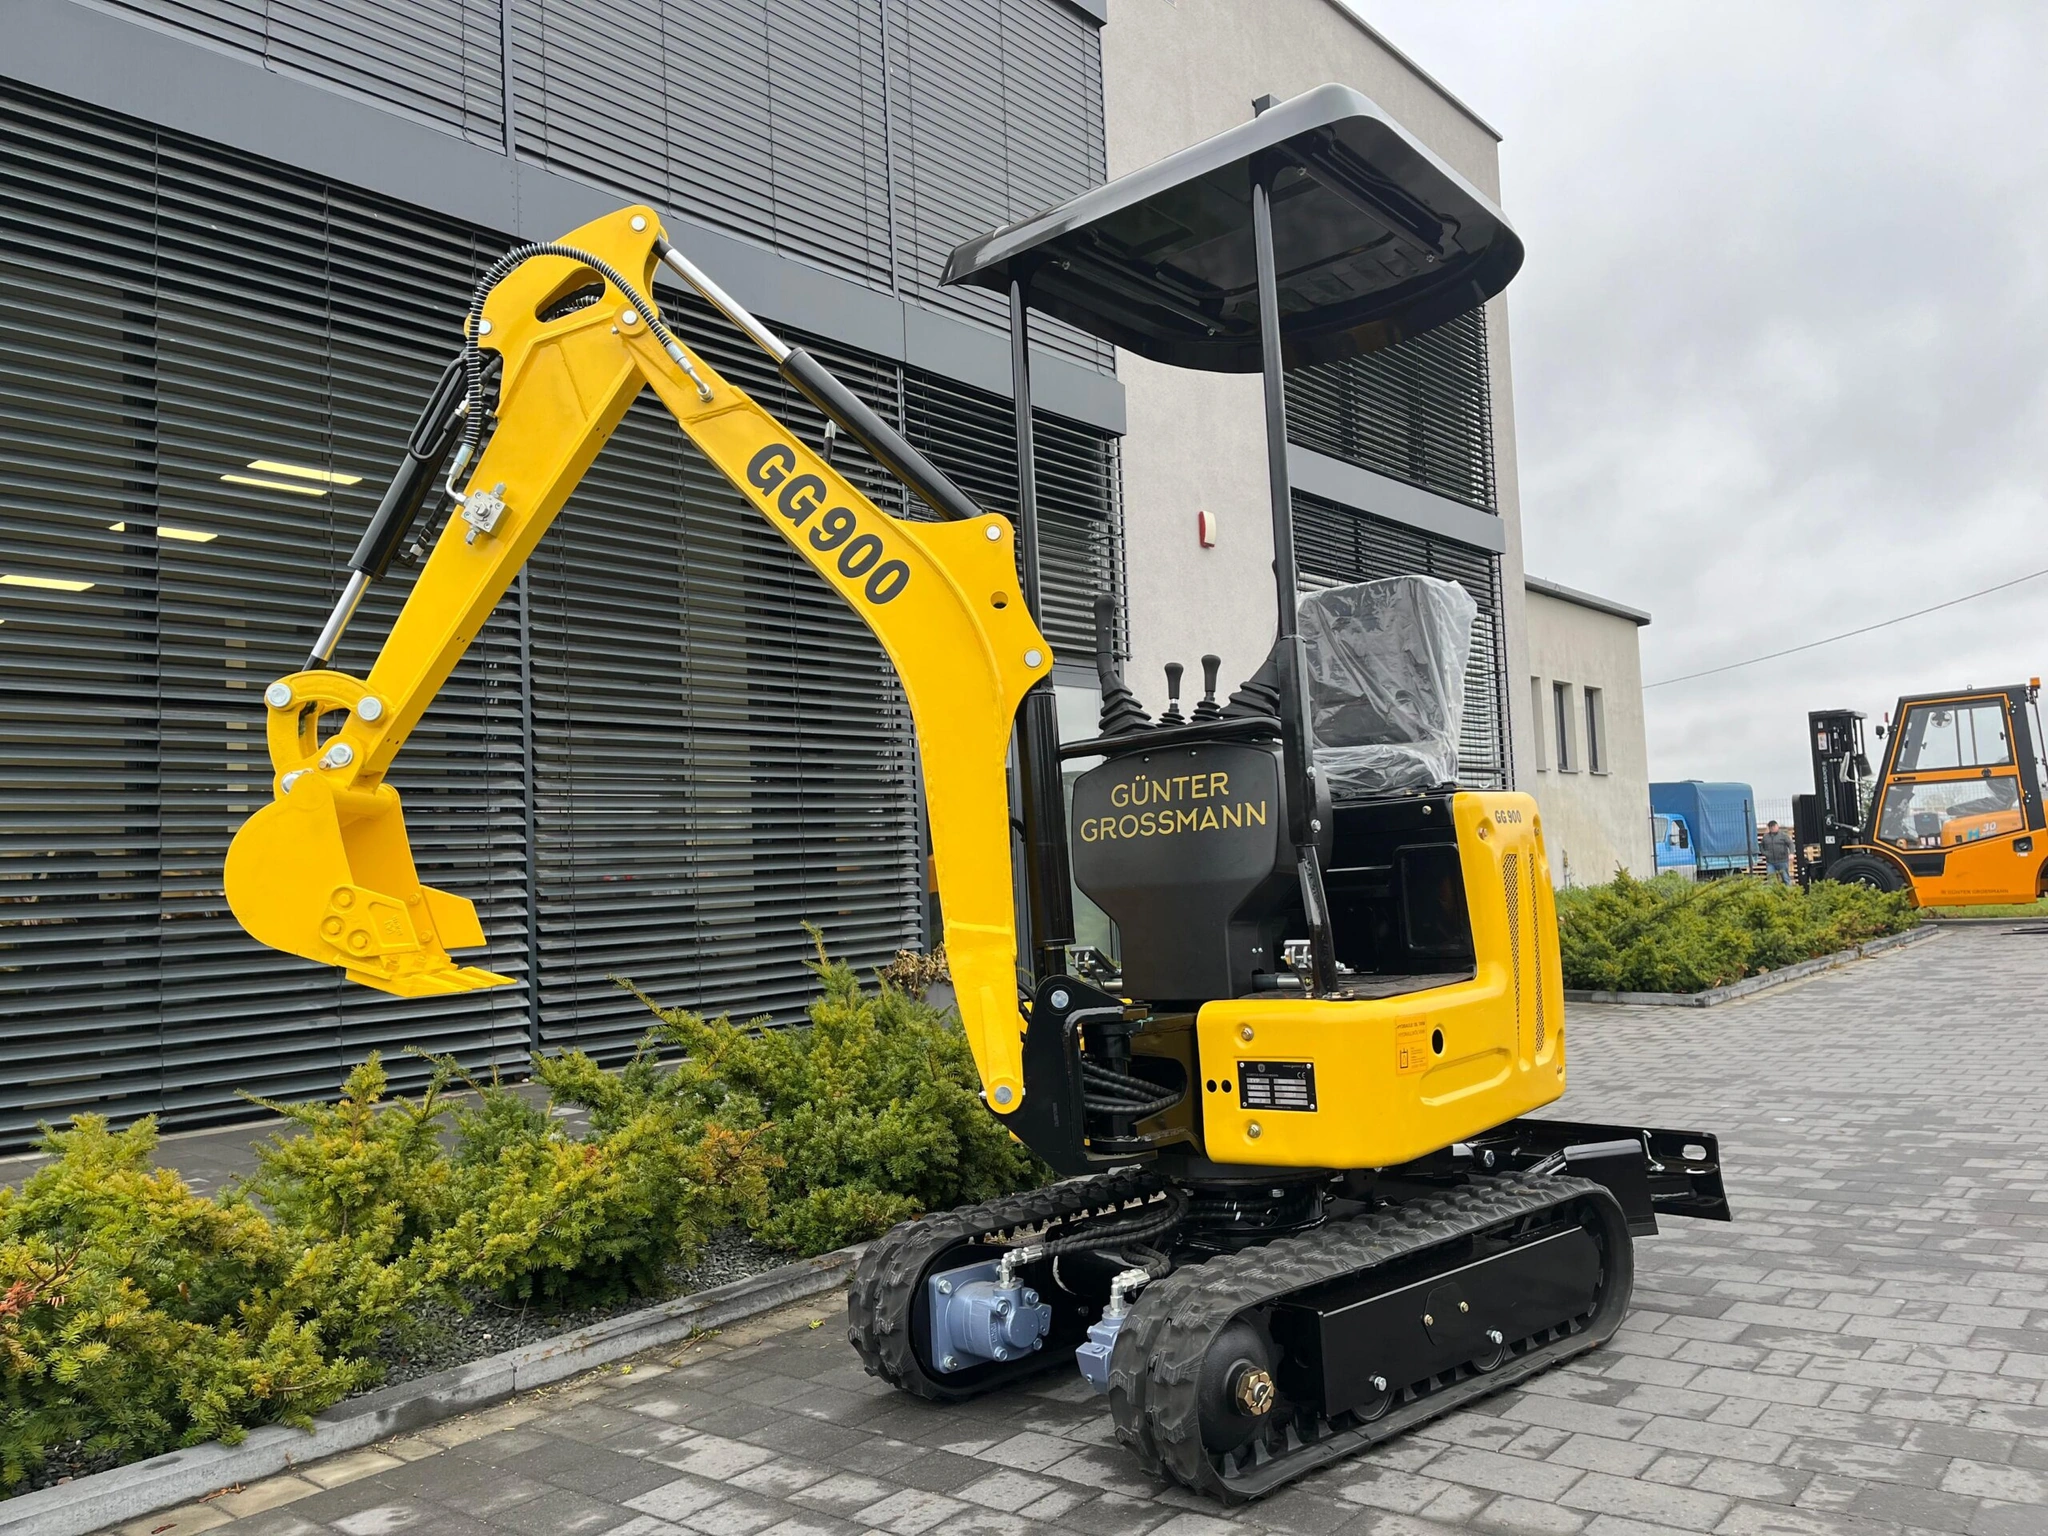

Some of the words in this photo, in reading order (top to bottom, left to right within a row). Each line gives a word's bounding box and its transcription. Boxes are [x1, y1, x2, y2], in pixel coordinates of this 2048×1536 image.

[746, 443, 910, 605] GG900
[1111, 772, 1230, 808] GÜNTER
[1080, 800, 1266, 842] GROSSMANN
[1494, 810, 1507, 824] GG
[1507, 810, 1522, 824] 900
